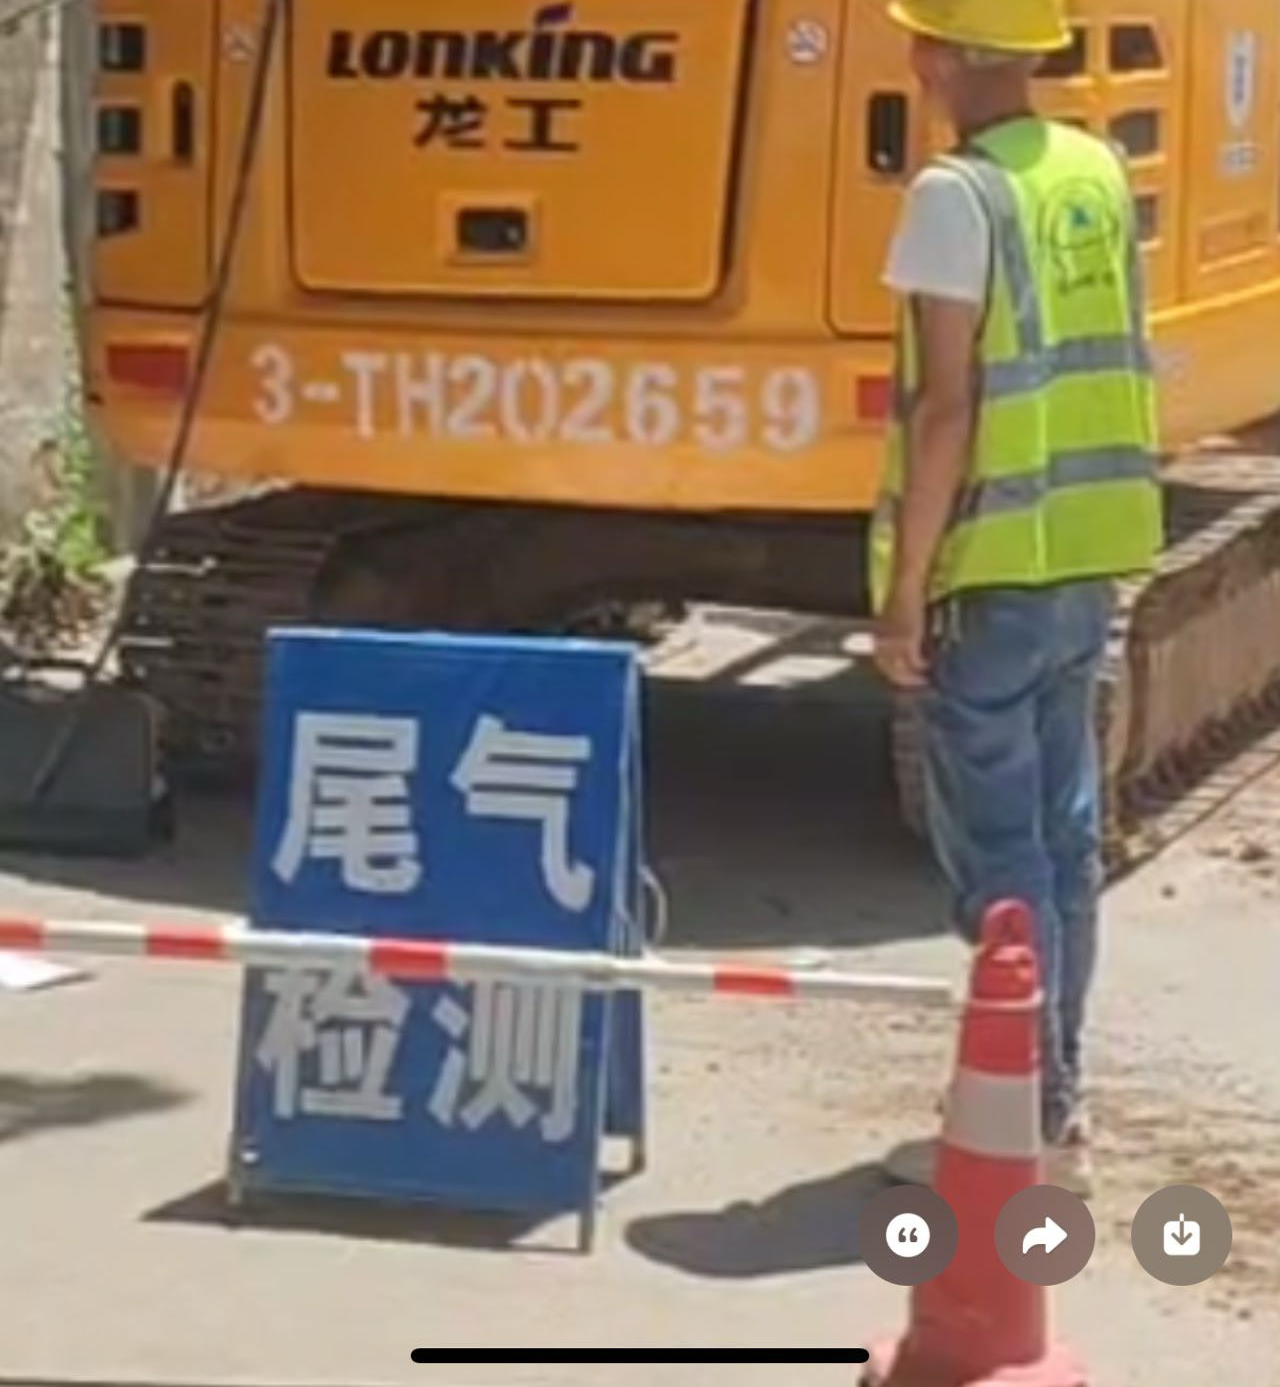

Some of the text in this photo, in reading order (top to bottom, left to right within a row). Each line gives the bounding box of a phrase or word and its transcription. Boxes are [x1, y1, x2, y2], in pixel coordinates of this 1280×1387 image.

[412, 94, 583, 153] 龙工
[250, 344, 820, 451] 3-TH202659
[271, 711, 596, 912] 尾气
[256, 958, 586, 1143] 检测
